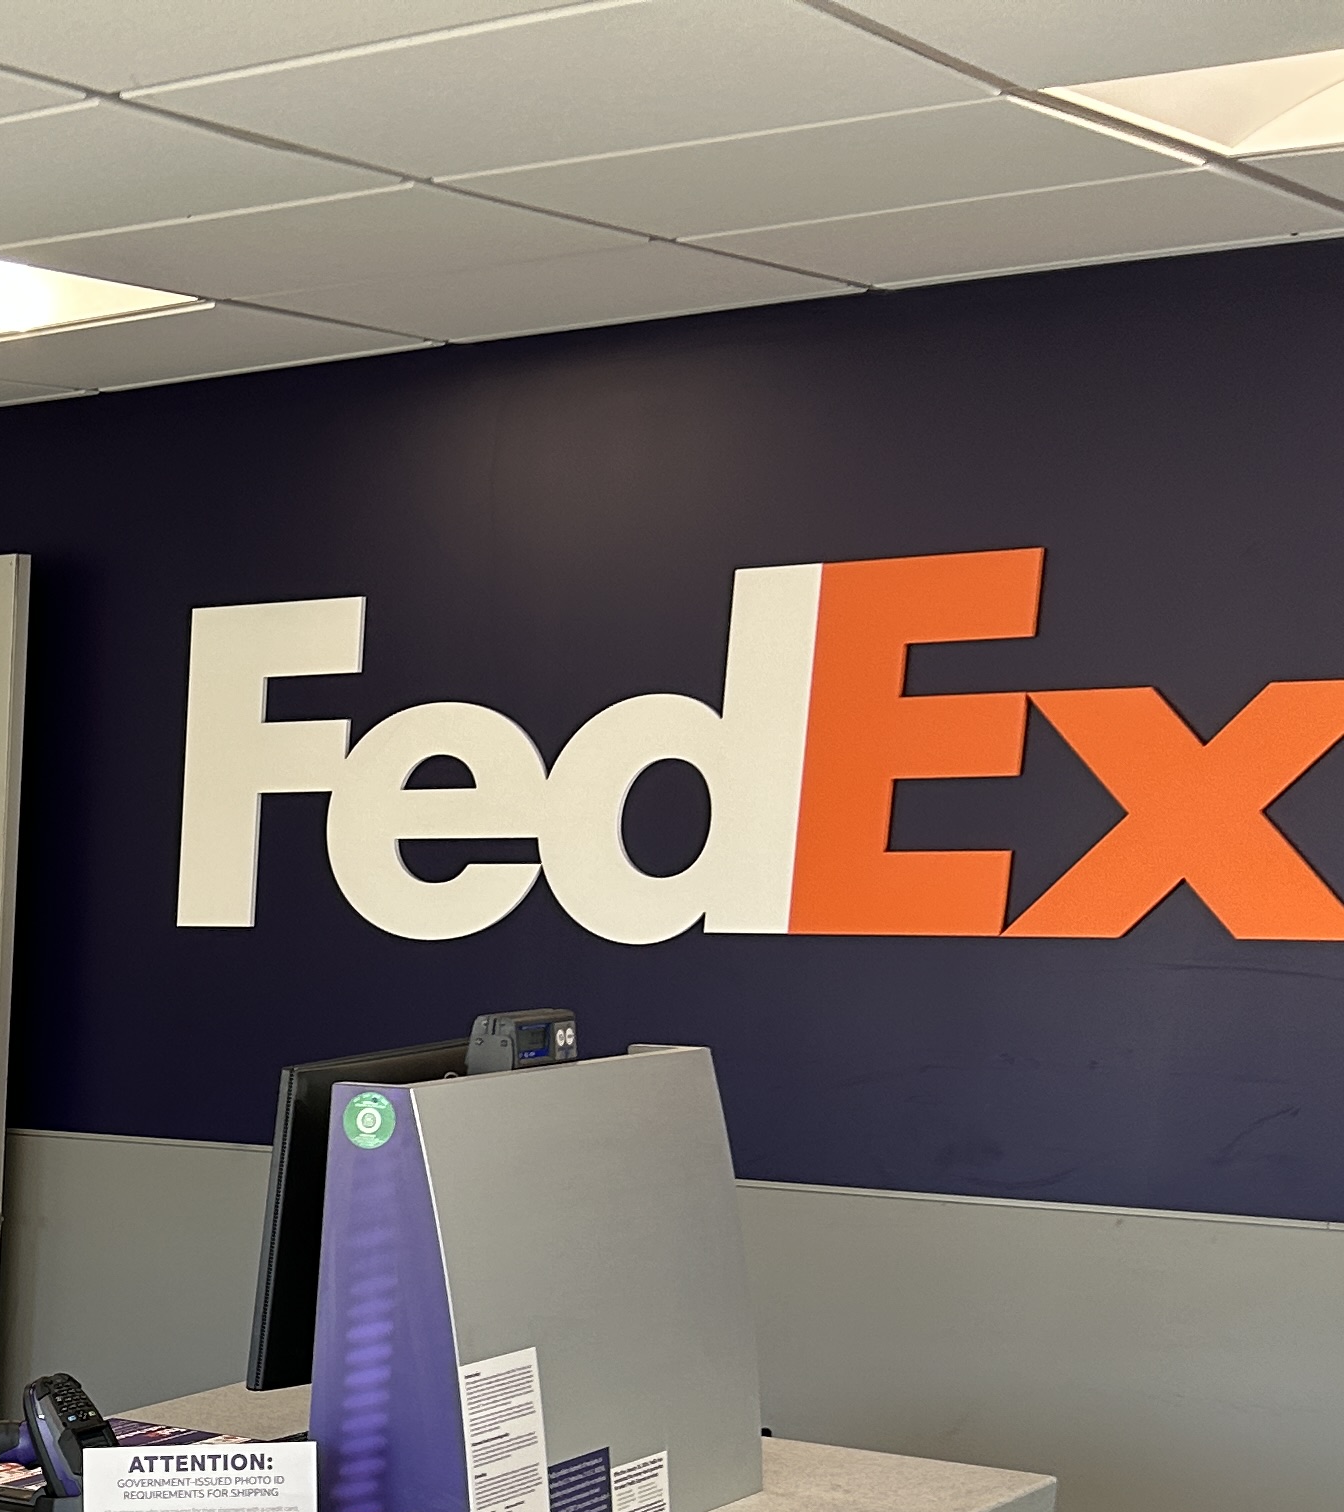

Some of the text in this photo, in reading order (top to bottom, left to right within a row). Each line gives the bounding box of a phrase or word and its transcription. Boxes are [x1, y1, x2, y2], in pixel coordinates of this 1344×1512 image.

[176, 546, 1344, 945] FedEx
[128, 1453, 273, 1473] ATTENTION:
[117, 1476, 285, 1488] GOVERNMENT-ISSUED PHOTO ID
[124, 1488, 279, 1500] REQUIREMENTS FOR SHIPPING
